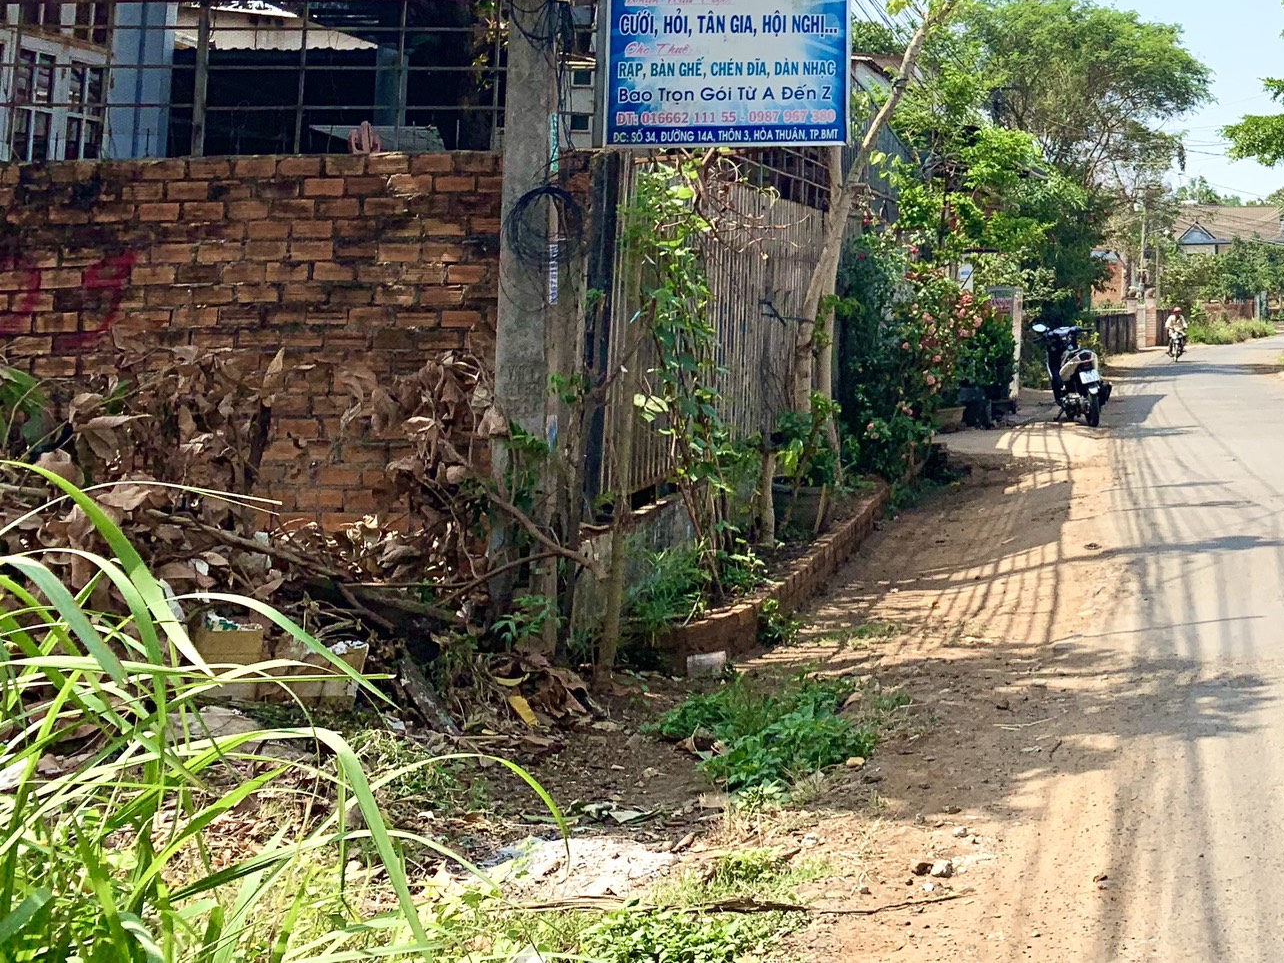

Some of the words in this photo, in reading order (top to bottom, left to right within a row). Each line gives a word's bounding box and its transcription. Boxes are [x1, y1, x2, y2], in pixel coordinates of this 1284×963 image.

[620, 10, 658, 37] CƯỚI,
[663, 8, 692, 37] HỎI,
[730, 15, 757, 37] GIA,
[763, 9, 787, 37] HỘI
[792, 15, 838, 38] NGHỊ...
[618, 61, 647, 80] RẠP,
[651, 59, 675, 77] BÀN
[678, 57, 706, 79] GHẾ,
[711, 58, 743, 77] CHÉN
[747, 58, 770, 78] ĐĨA,
[775, 57, 799, 76] DÀN
[803, 61, 836, 78] NHẠC
[619, 88, 652, 102] Bao
[658, 87, 695, 105] Trọn
[700, 85, 732, 102] Gói
[738, 85, 757, 101] Từ
[762, 86, 775, 100] A
[781, 84, 816, 100] Đến
[822, 86, 832, 99] Z
[616, 112, 638, 126] ĐT:
[642, 112, 688, 124] 016662
[694, 111, 716, 123] 111
[721, 111, 737, 123] 55
[748, 110, 780, 124] 0987
[784, 109, 808, 124] 967
[613, 131, 629, 143] ĐC:
[631, 127, 643, 143] SỐ
[645, 131, 659, 143] 34,
[660, 127, 695, 143] ĐƯỜNG
[697, 130, 716, 142] 14A,
[718, 127, 742, 142] THÔN
[743, 130, 752, 142] 3,
[753, 126, 774, 140] HÒA
[775, 126, 808, 142] THUẬN,
